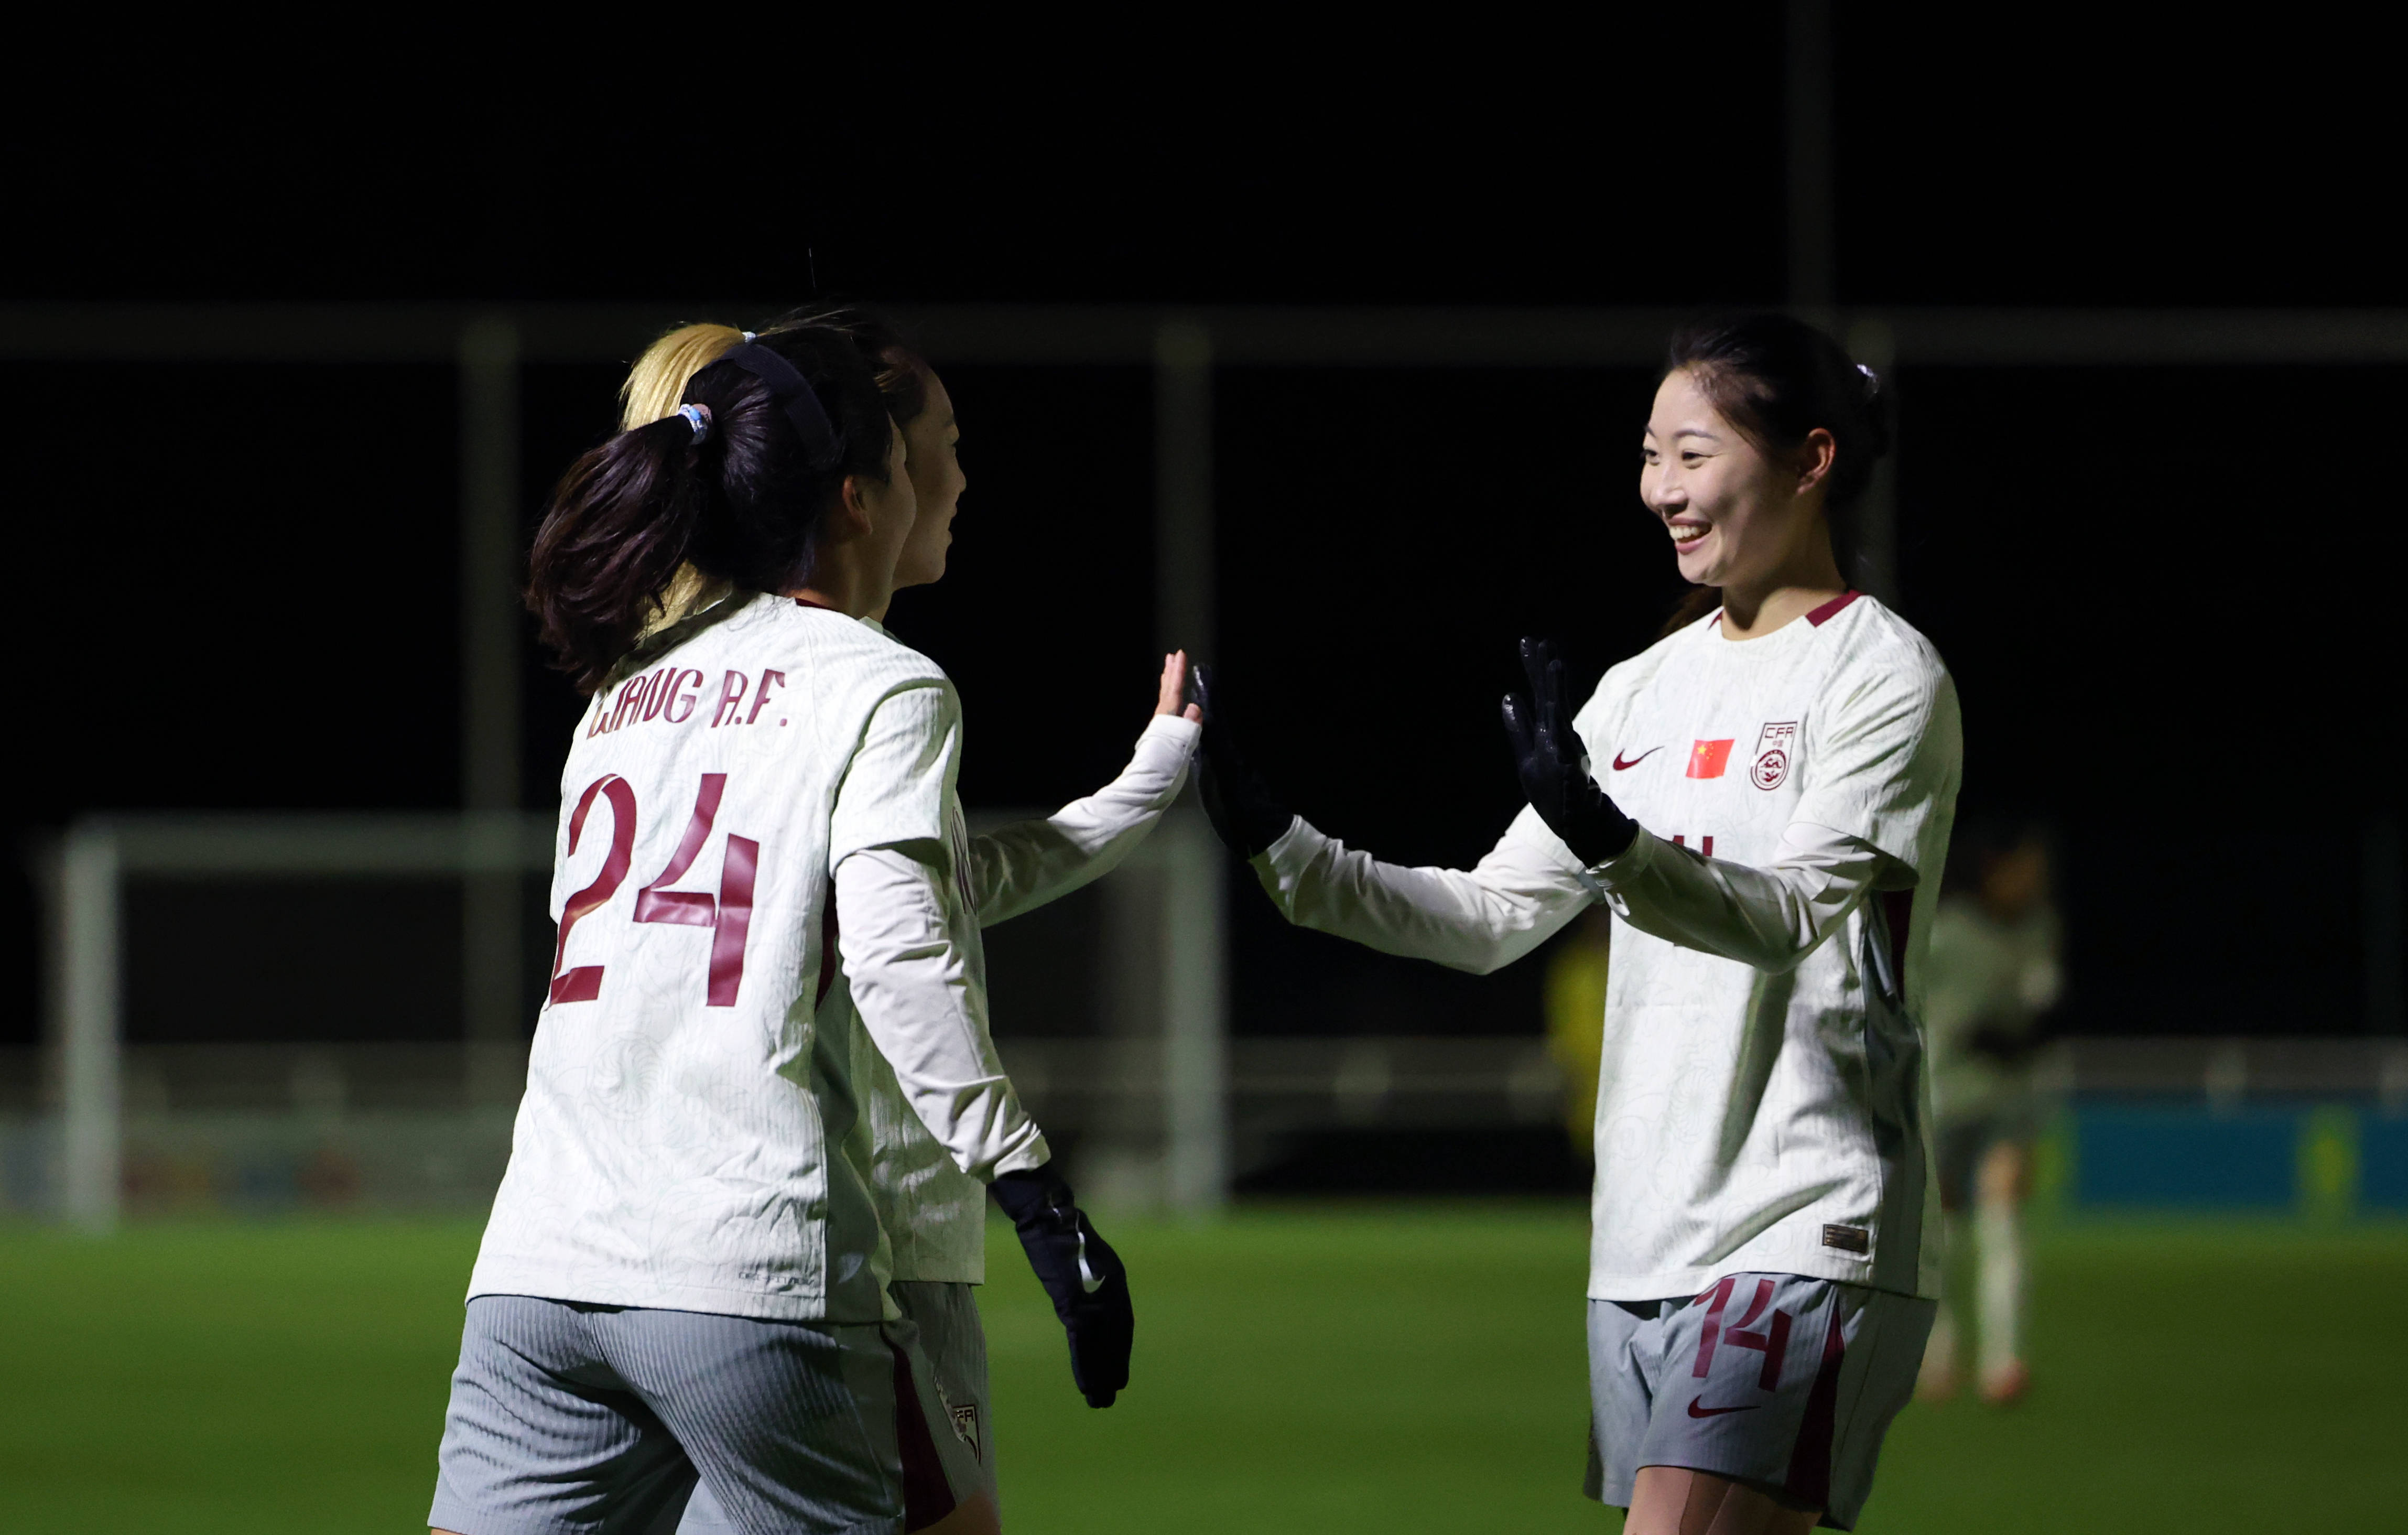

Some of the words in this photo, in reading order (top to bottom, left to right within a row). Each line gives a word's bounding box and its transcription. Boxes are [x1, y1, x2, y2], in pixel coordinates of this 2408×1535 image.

[587, 667, 703, 740] WANG
[711, 669, 788, 728] A.F.
[1765, 727, 1794, 738] CFA
[545, 773, 759, 1007] 24
[1691, 1278, 1792, 1392] 14
[952, 1409, 974, 1422] FA
